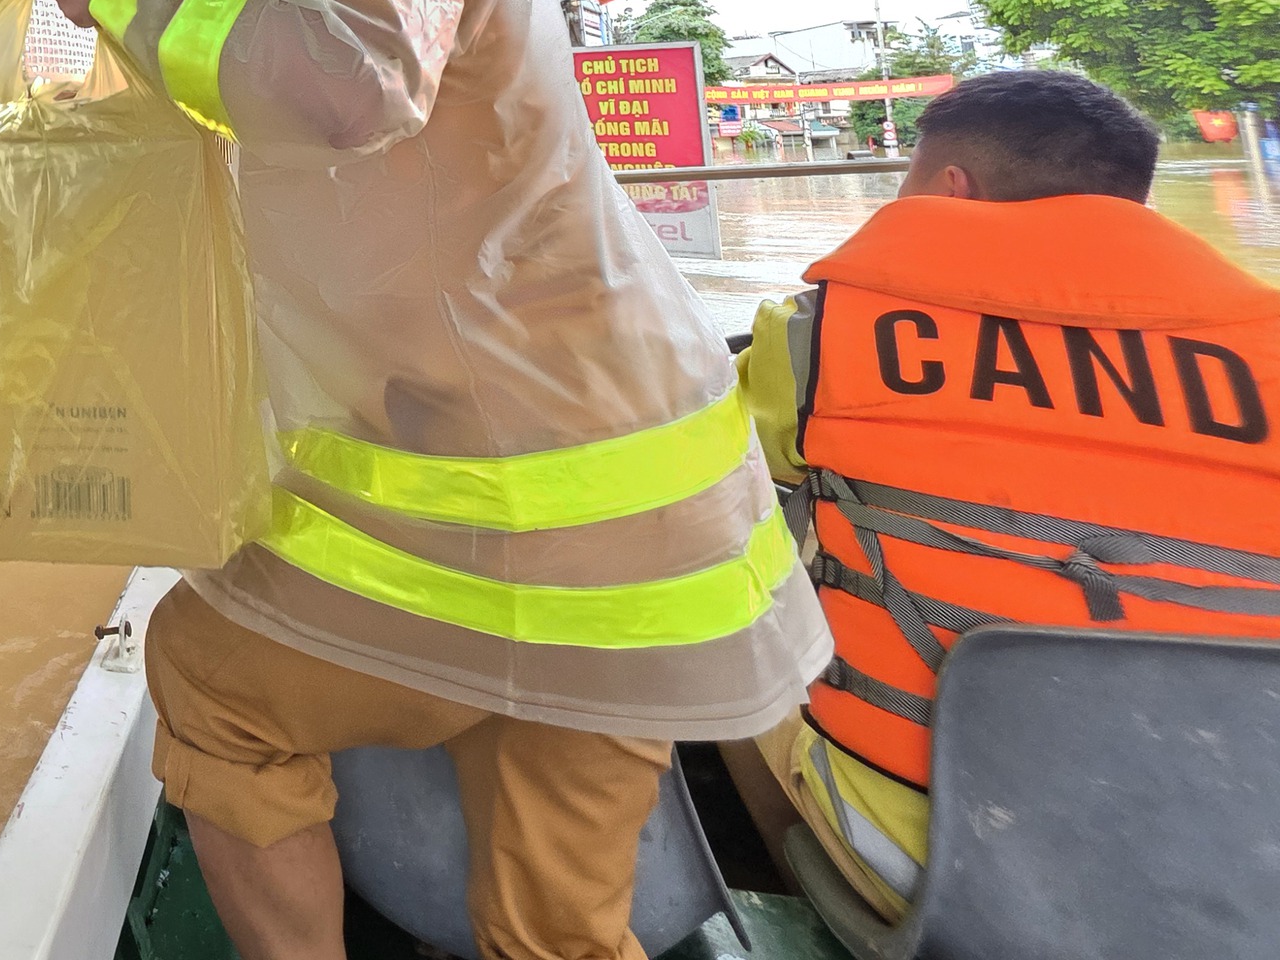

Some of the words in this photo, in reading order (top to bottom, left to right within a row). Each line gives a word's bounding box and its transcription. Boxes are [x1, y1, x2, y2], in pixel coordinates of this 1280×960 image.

[582, 56, 616, 75] CHỦ
[619, 58, 659, 76] TỊCH
[596, 77, 625, 95] CHÍ
[628, 78, 677, 94] MINH
[598, 99, 616, 115] VĨ
[619, 100, 649, 117] ĐẠI
[634, 118, 669, 136] MÃI
[599, 142, 657, 157] TRONG
[873, 309, 1270, 445] CAND
